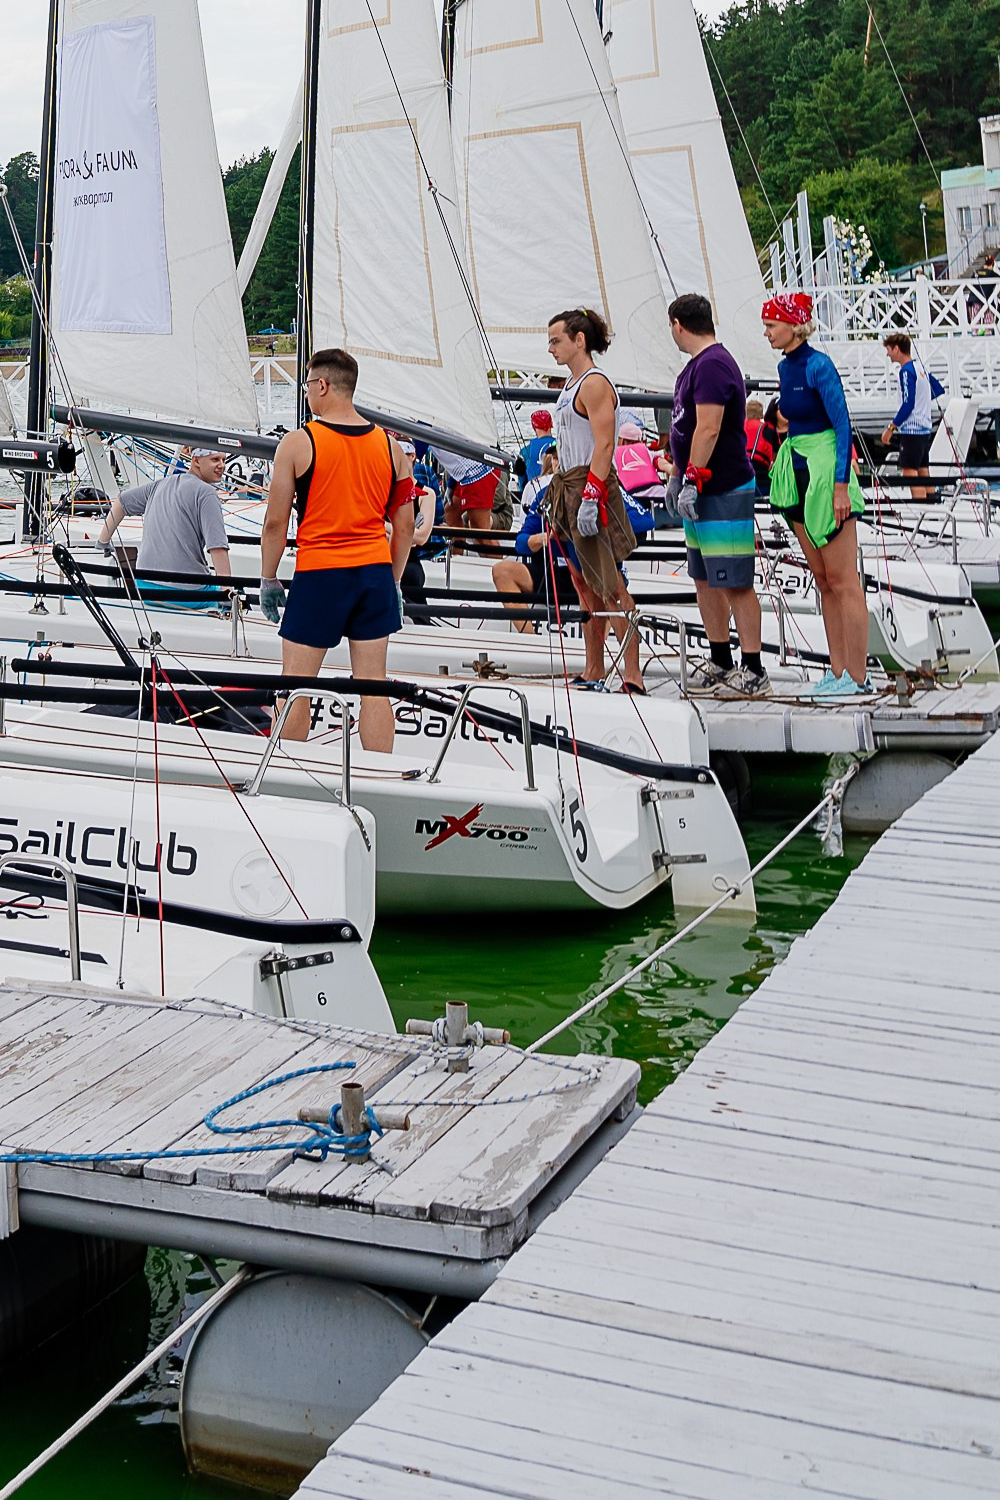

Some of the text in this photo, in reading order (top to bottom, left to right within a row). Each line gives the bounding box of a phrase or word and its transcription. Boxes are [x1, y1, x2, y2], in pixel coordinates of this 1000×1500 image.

[46, 451, 55, 469] 5
[886, 606, 898, 642] 3
[414, 803, 529, 851] MX700
[568, 797, 588, 863] 5
[678, 817, 687, 830] 5
[317, 991, 328, 1006] 6
